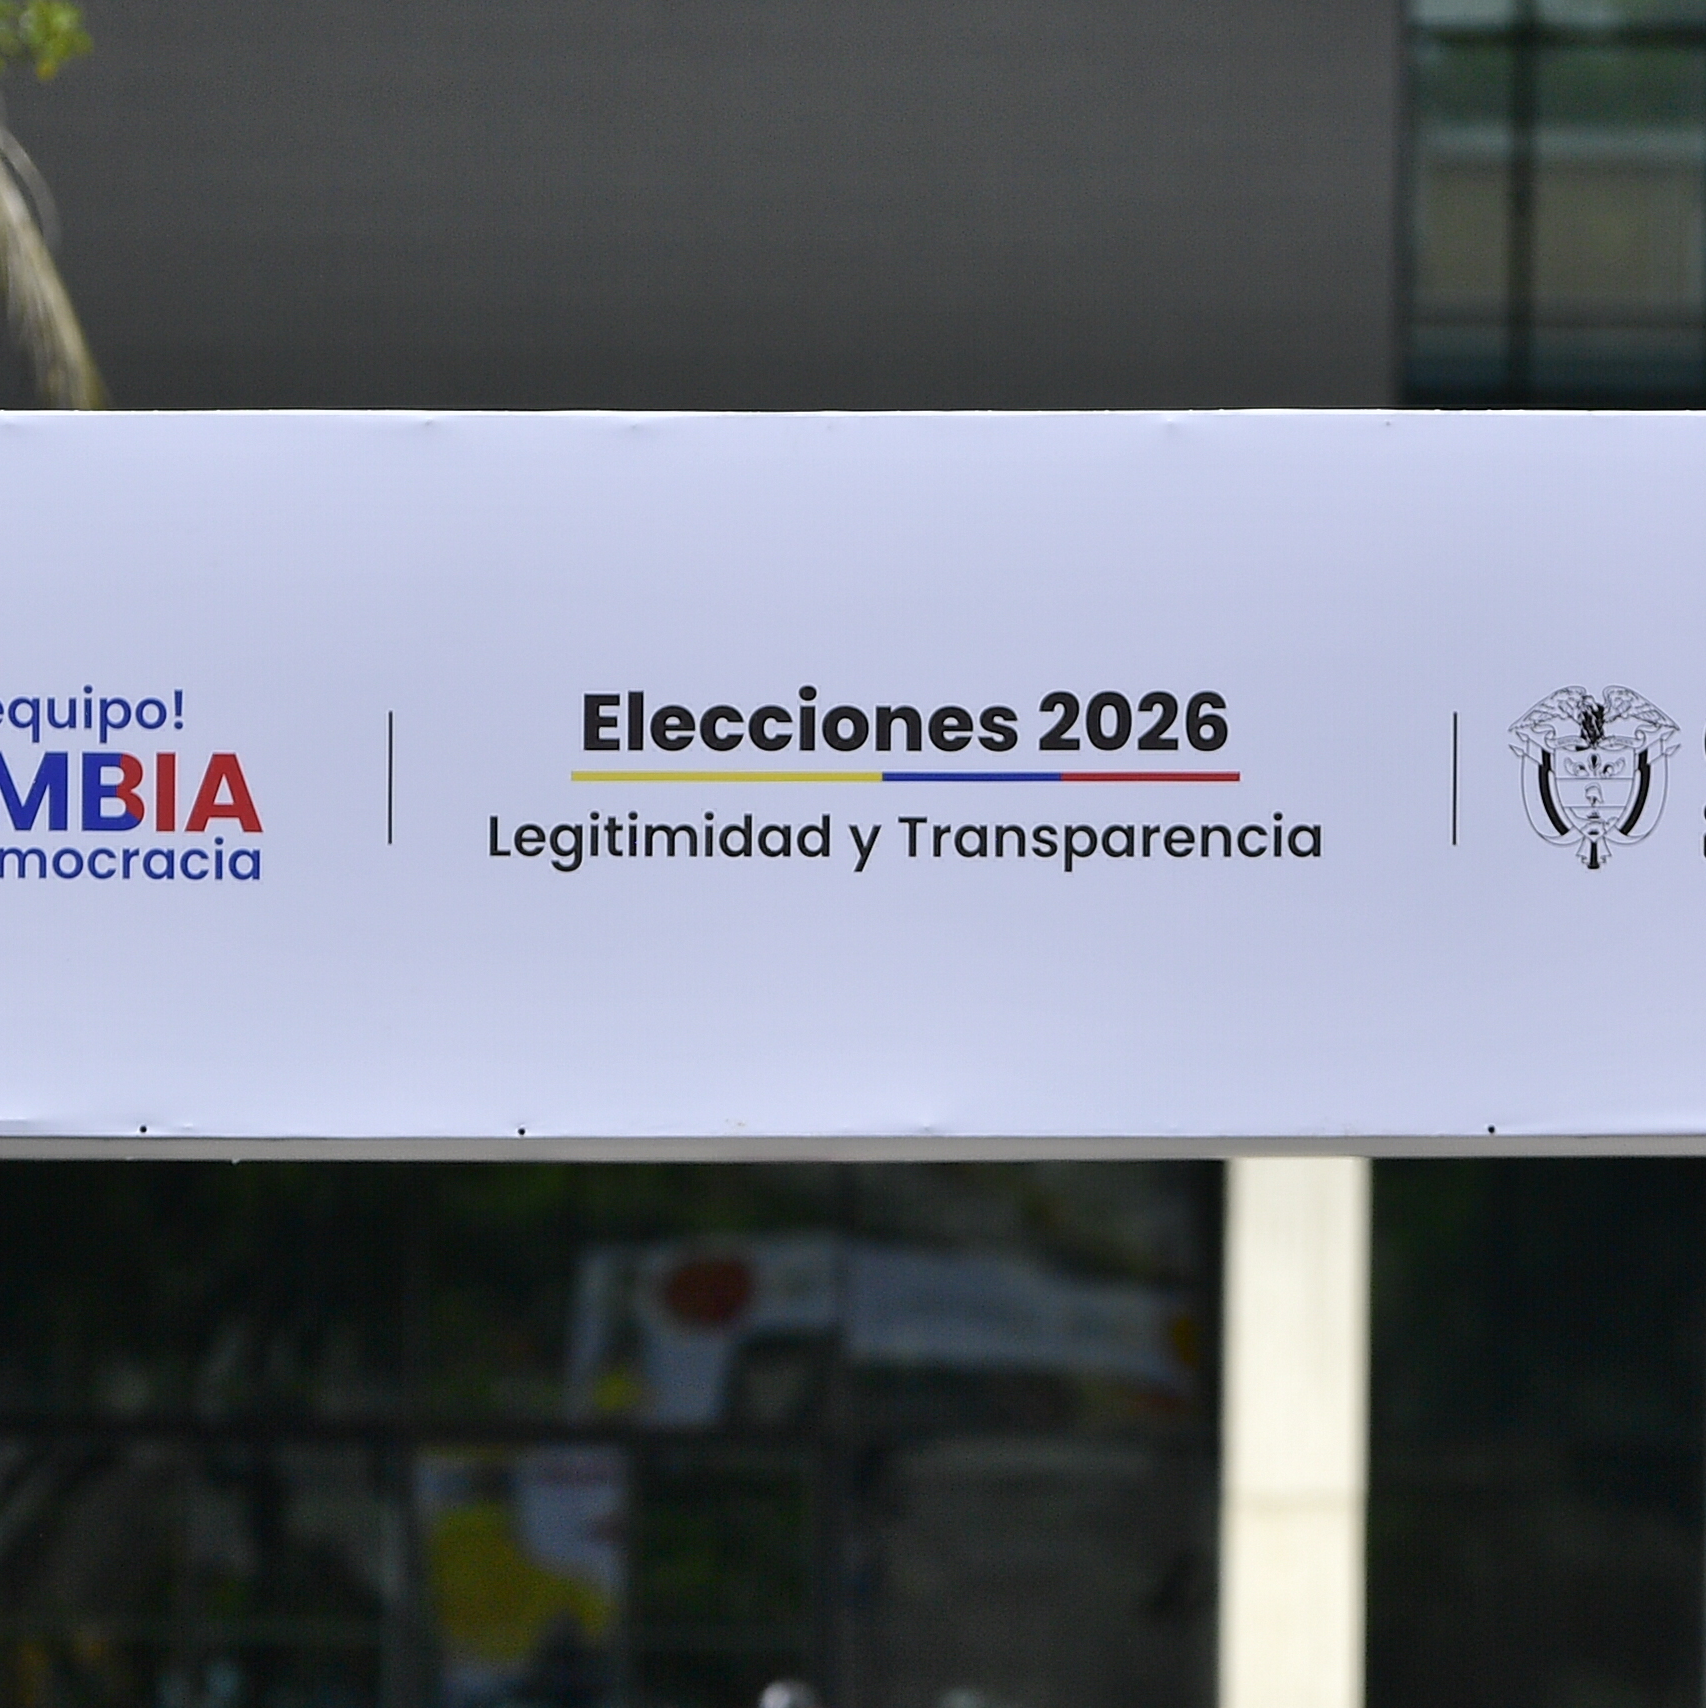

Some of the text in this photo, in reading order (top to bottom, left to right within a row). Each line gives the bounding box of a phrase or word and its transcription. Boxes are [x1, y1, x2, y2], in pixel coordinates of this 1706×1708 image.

[583, 685, 1230, 753] Elecciones 2026
[489, 811, 1323, 874] Legitimidad y Transparencia
